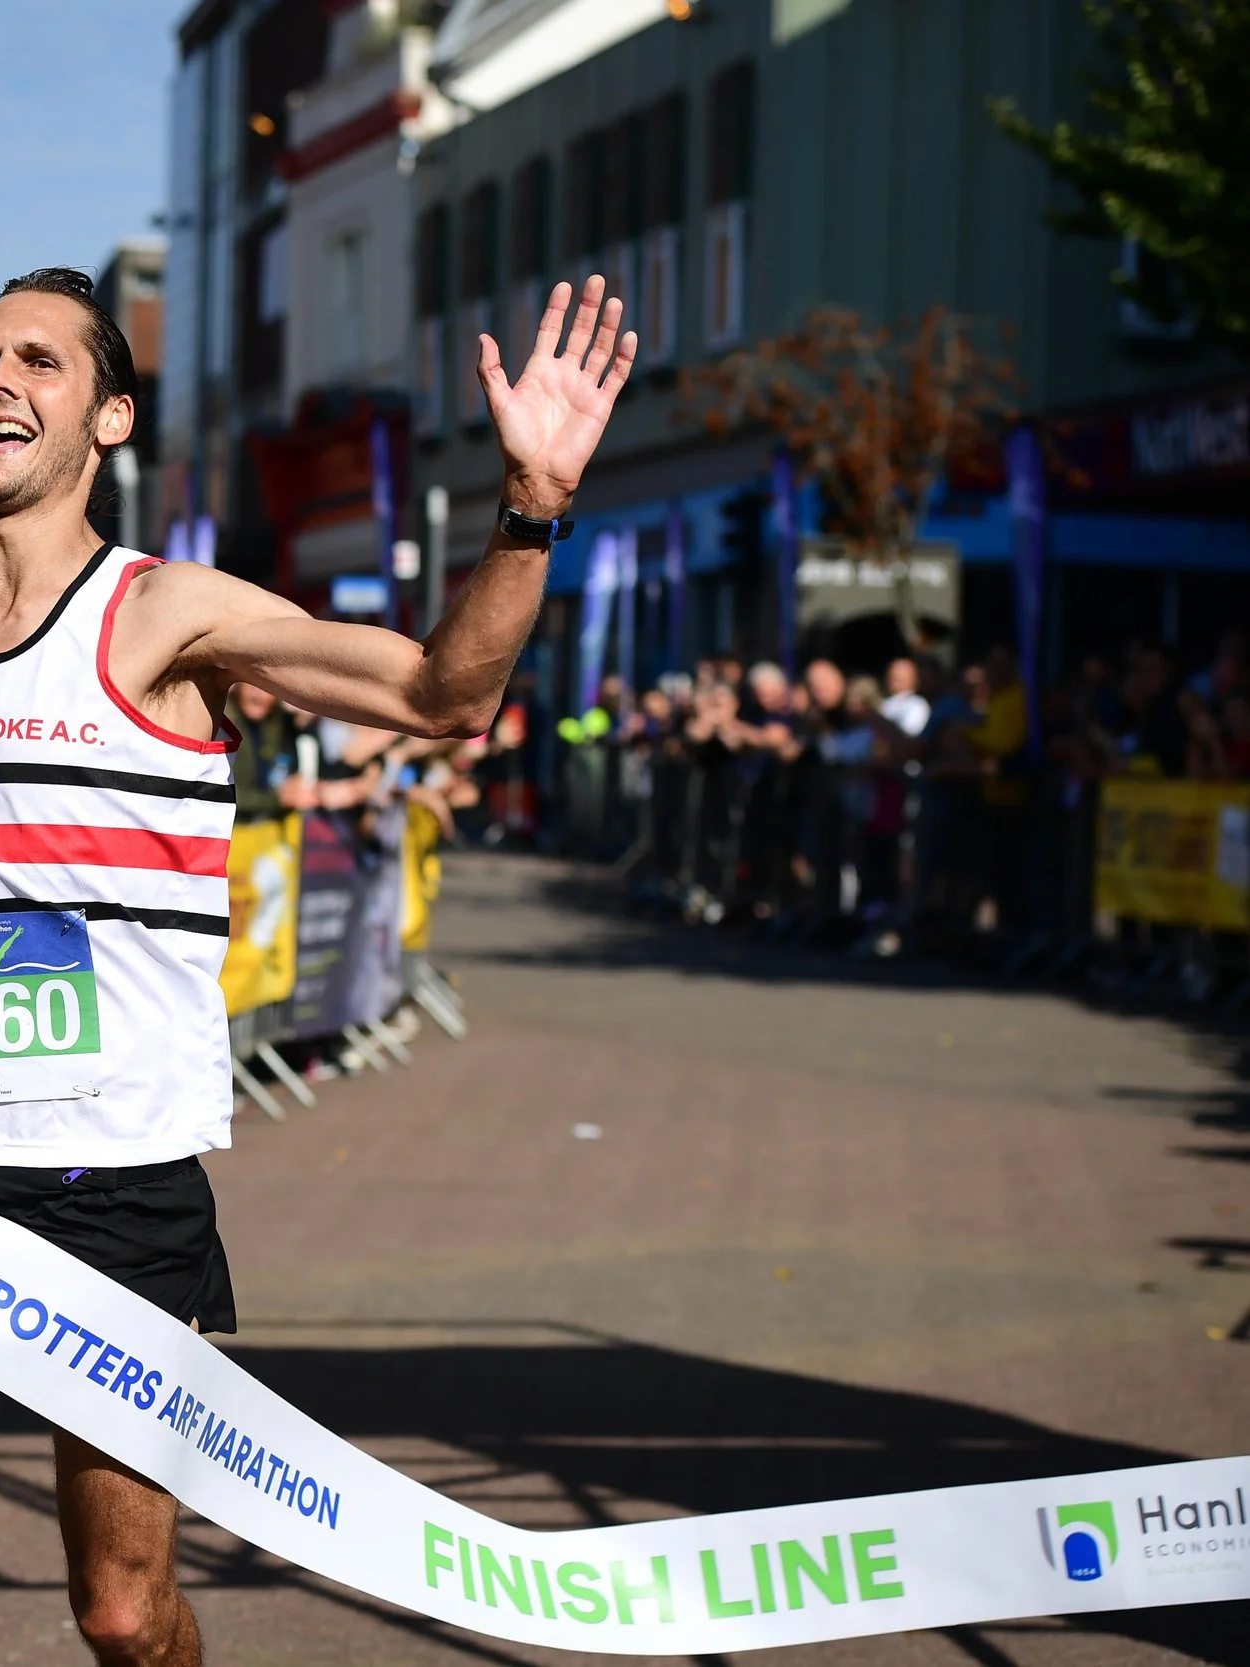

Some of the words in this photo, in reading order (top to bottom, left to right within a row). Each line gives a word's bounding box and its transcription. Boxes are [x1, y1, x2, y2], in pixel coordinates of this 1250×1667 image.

[49, 720, 105, 746] A.C.
[196, 1412, 341, 1531] MARATHON
[1136, 1487, 1247, 1534] Hanl
[1144, 1537, 1250, 1559] ECONOMI
[423, 1520, 676, 1625] FINISH
[699, 1528, 905, 1620] LINE
